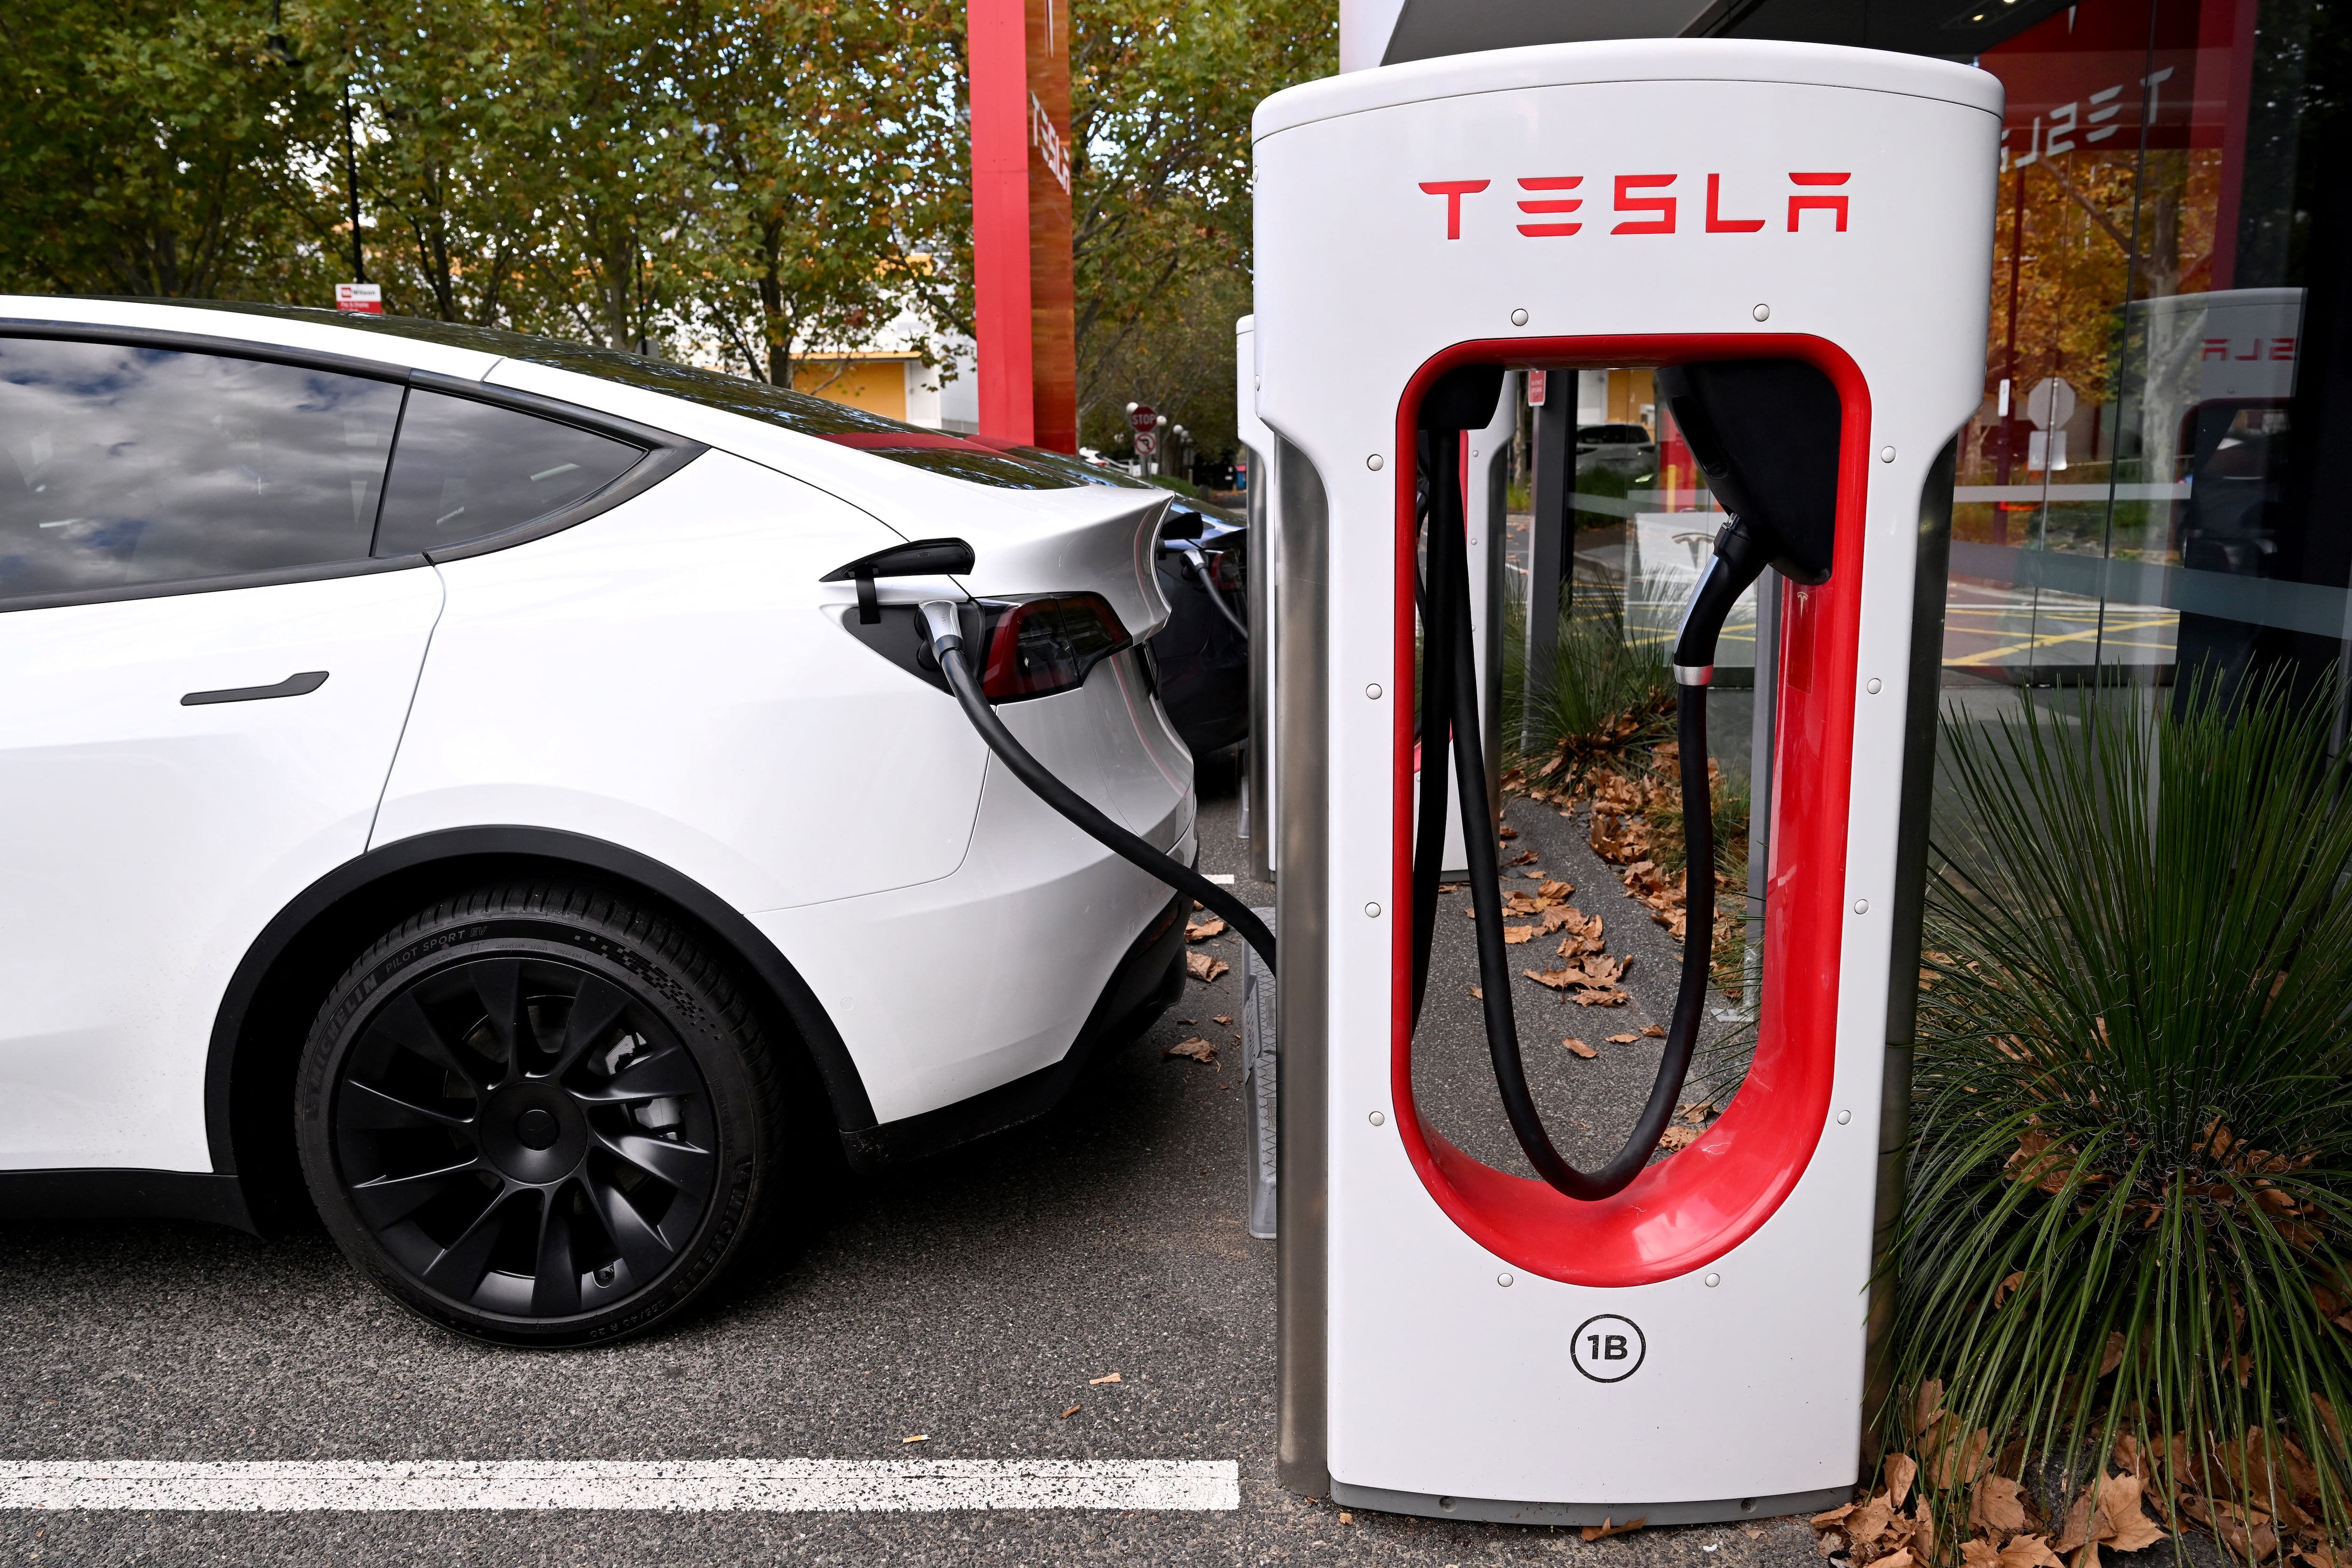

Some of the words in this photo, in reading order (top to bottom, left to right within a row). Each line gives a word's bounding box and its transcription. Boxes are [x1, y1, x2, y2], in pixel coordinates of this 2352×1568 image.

[1030, 90, 1071, 196] TESLA
[1419, 173, 1851, 240] TESLA
[1132, 414, 1156, 425] STOP
[555, 949, 582, 959] TUBELESS
[310, 974, 378, 1092] MICHELIN
[386, 947, 418, 973] PILOT
[422, 930, 465, 951] SPORT
[470, 926, 487, 937] EV
[673, 1188, 746, 1297] MICHELIN
[622, 1300, 667, 1327] 255/40
[590, 1328, 606, 1338] 20
[1587, 1334, 1628, 1360] 1B
